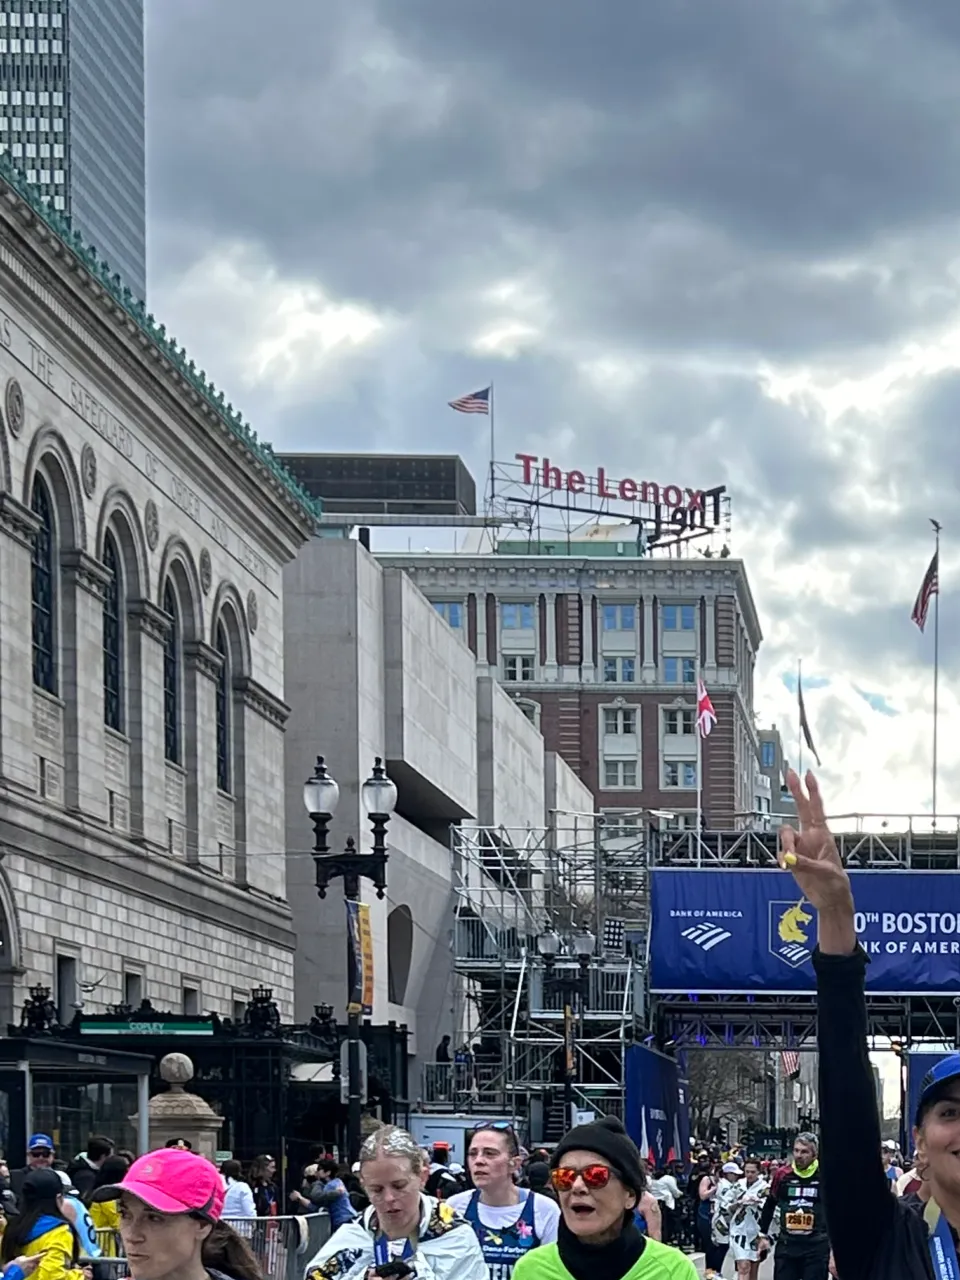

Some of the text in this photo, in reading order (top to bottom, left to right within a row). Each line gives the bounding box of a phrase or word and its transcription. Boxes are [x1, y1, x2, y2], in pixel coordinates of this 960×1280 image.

[28, 341, 55, 389] THE
[515, 453, 704, 512] The Lenox
[670, 910, 743, 918] BANK OF AMERICA
[853, 912, 879, 934] 0TH
[858, 941, 881, 954] NK
[885, 941, 907, 954] OF
[129, 1021, 165, 1031] COPLEY
